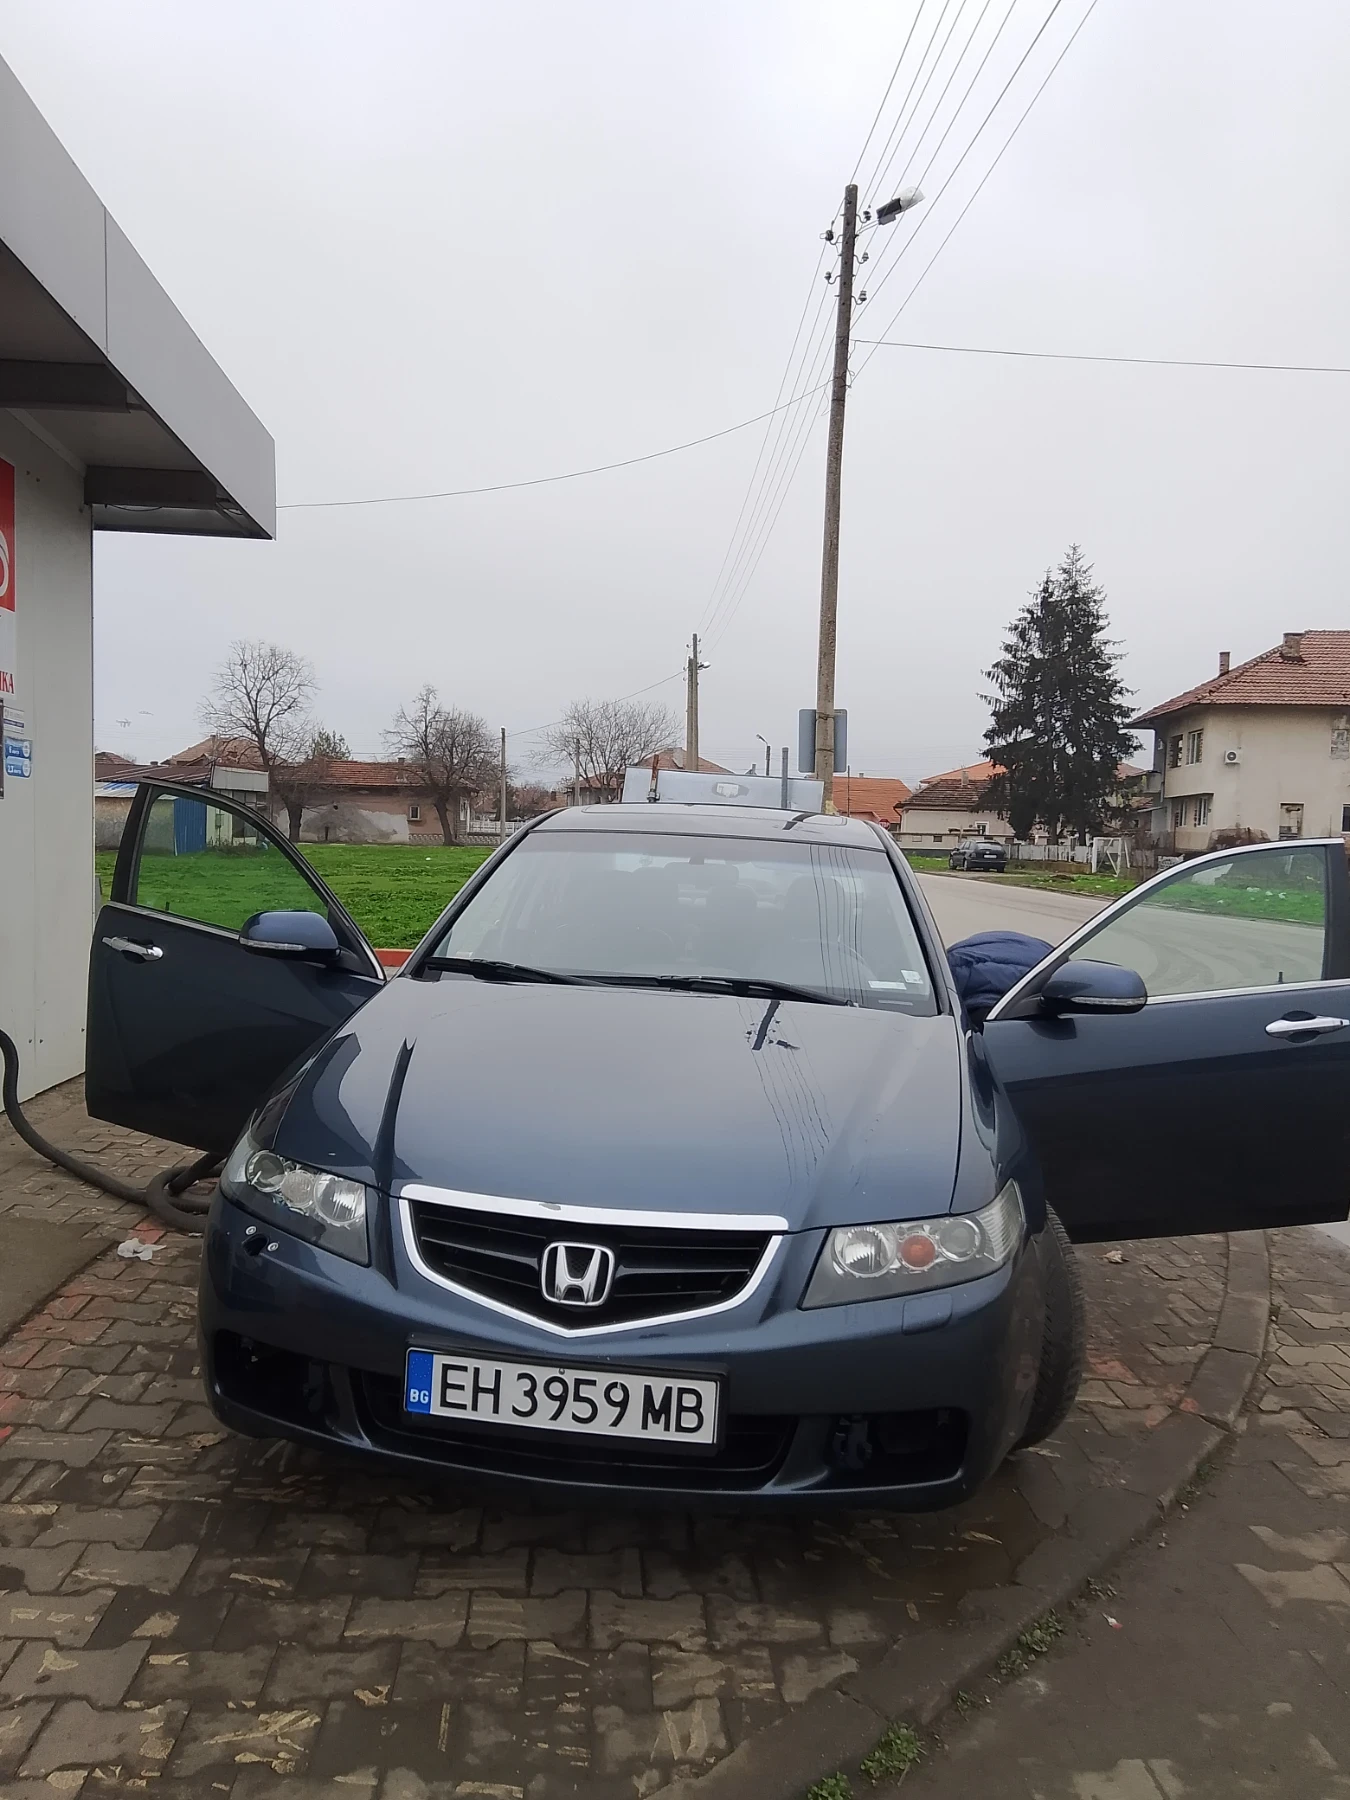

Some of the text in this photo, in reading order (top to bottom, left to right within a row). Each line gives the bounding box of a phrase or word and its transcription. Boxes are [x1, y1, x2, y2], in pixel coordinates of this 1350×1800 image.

[409, 1388, 429, 1404] BG
[439, 1362, 704, 1433] EH 3959 MB
